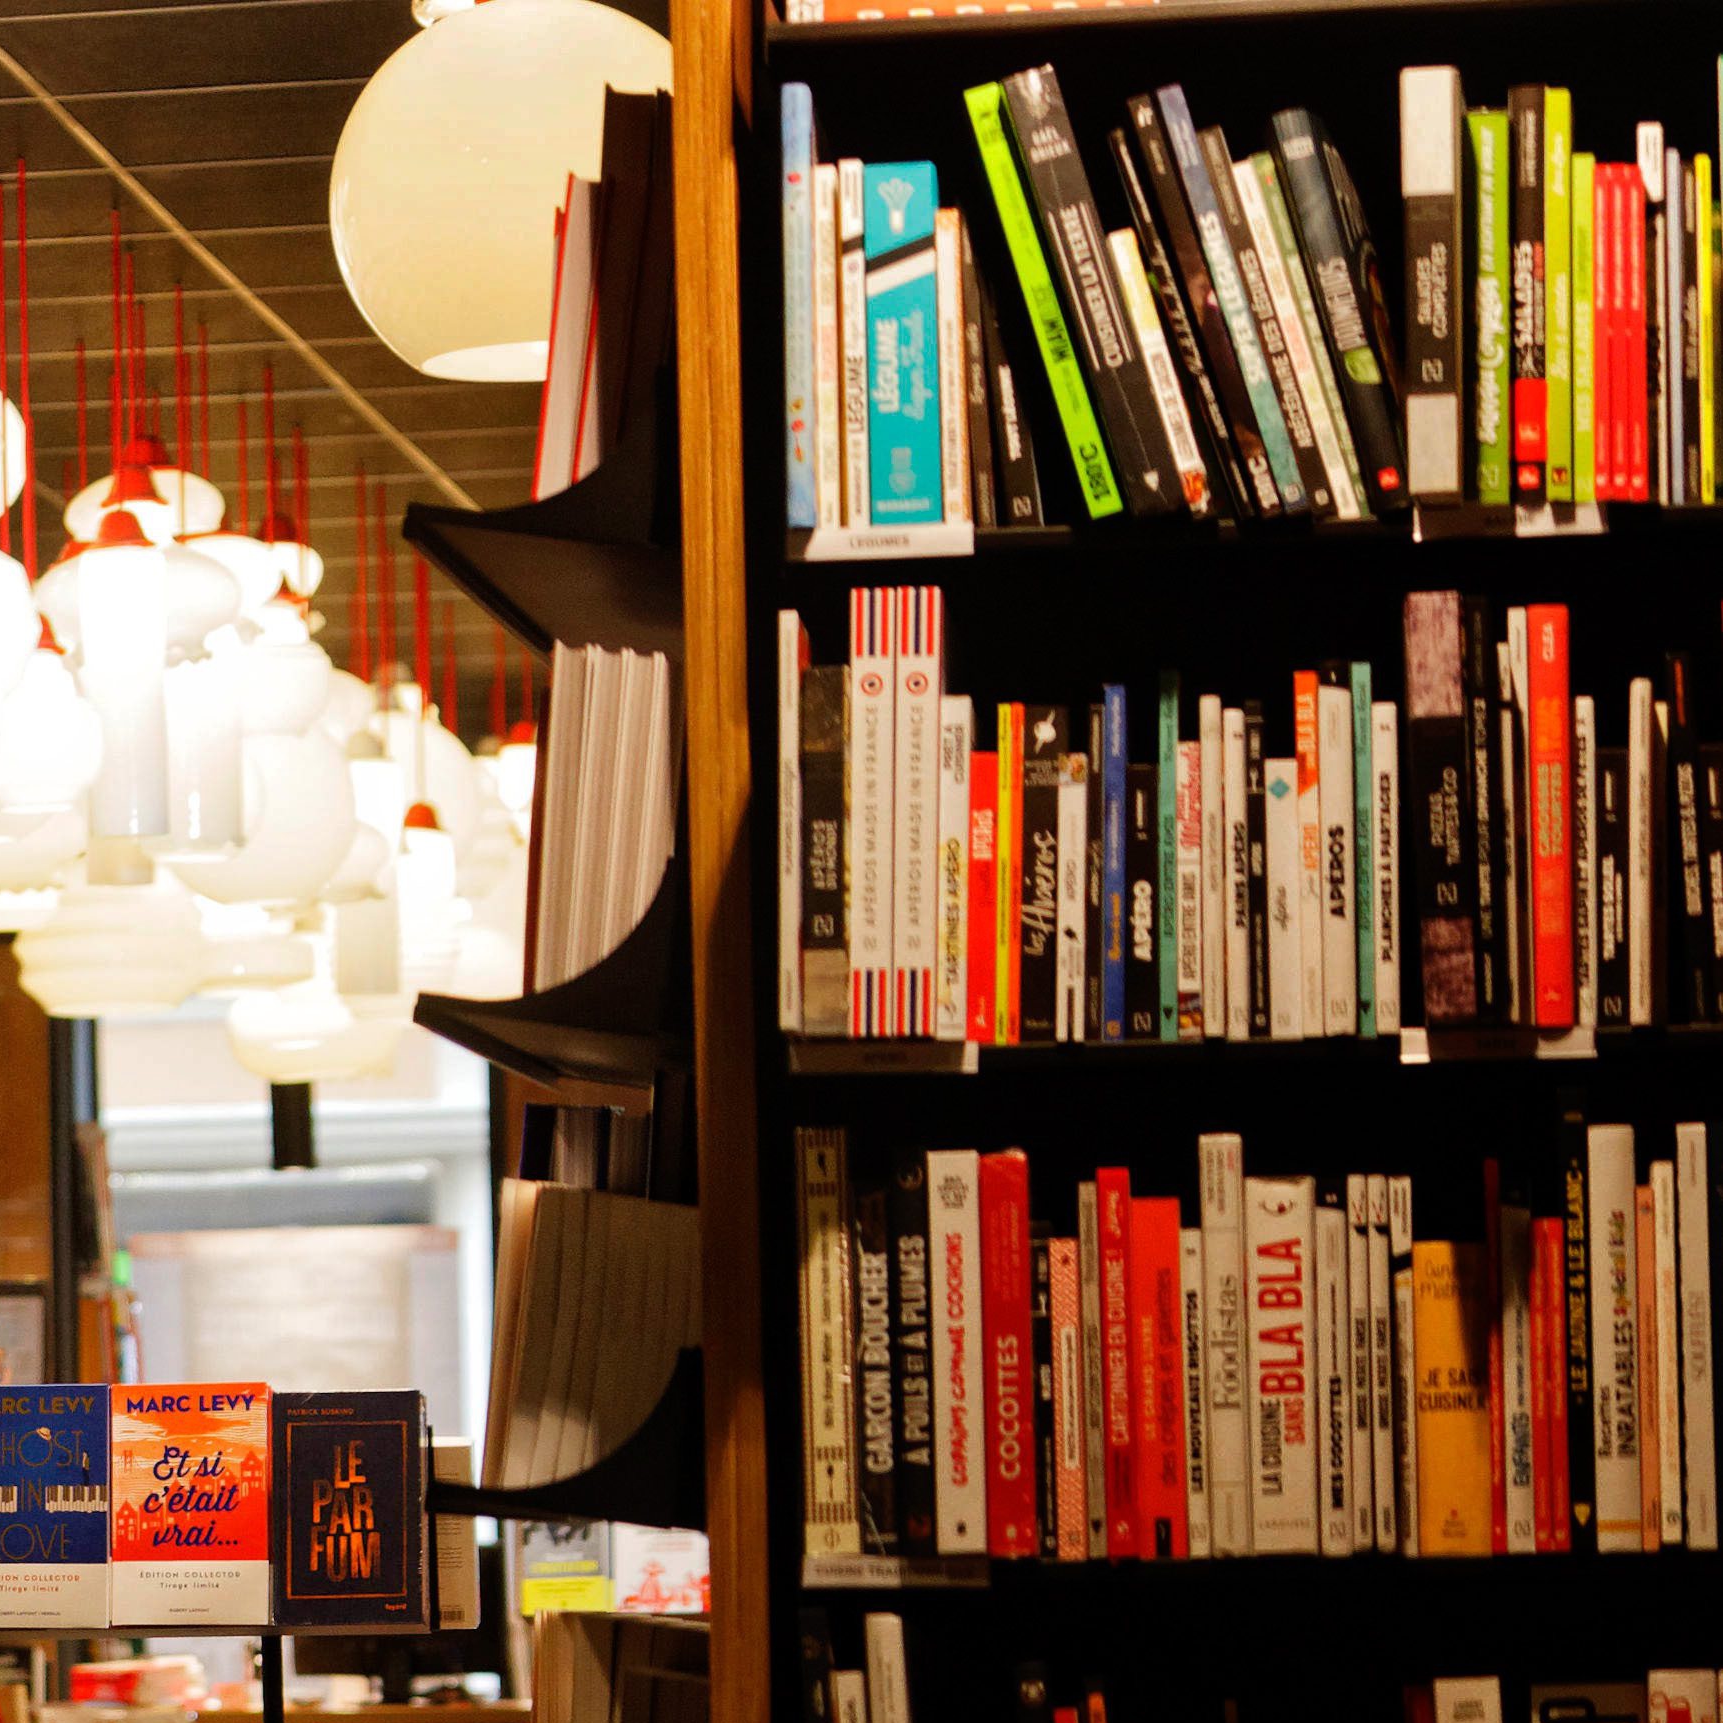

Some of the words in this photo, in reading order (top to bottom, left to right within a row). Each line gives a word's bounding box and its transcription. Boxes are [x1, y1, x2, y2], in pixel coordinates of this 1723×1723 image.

[1513, 240, 1535, 348] SALADES
[861, 705, 879, 771] FRANCE
[906, 705, 923, 771] FRANCE
[862, 776, 878, 798] IN
[907, 776, 923, 798] IN
[1377, 772, 1393, 857] PARTAGER
[862, 804, 879, 851] MADE
[907, 803, 923, 850] MADE
[860, 857, 879, 928] APÉROS
[906, 857, 924, 927] APÉROS
[1325, 825, 1348, 920] APÉROS
[945, 900, 961, 985] TARTINES
[1128, 879, 1153, 962] APÉRO
[1378, 876, 1394, 962] PLANCHES
[1566, 1170, 1584, 1241] BLANC
[899, 1235, 927, 1325] PLUMES
[944, 1232, 965, 1321] COCHONS
[1256, 1237, 1303, 1310] BLA
[861, 1250, 892, 1366] BOUCHER
[1569, 1290, 1587, 1361] JAUNE
[1208, 1272, 1242, 1412] Foodistas
[1257, 1322, 1305, 1395] BLA
[39, 1396, 95, 1415] LEVY
[126, 1394, 192, 1415] MARC
[198, 1393, 257, 1413] LEVY
[904, 1376, 930, 1441] POILS
[996, 1333, 1023, 1480] COCOTTES
[1422, 1368, 1446, 1389] JE
[1571, 1364, 1587, 1392] LE
[1613, 1316, 1636, 1457] INRATABLES
[1186, 1373, 1203, 1460] NOUVEAUX
[1260, 1399, 1283, 1469] CUISINE
[1282, 1398, 1305, 1444] SANS
[1329, 1375, 1345, 1469] COCOTTES
[153, 1444, 191, 1480] Et
[193, 1450, 224, 1478] si
[334, 1440, 366, 1489] LE
[1187, 1462, 1204, 1493] LES
[1261, 1473, 1283, 1496] LA
[312, 1478, 376, 1535] PAR
[0, 1584, 29, 1594] Tirage
[32, 1583, 60, 1593] limité
[23, 1573, 81, 1583] COLLECTOR
[139, 1569, 180, 1580] ÉDITION
[182, 1570, 242, 1580] COLLECTOR
[160, 1581, 189, 1591] Tirage
[193, 1580, 221, 1590] limité
[310, 1529, 381, 1584] FUM
